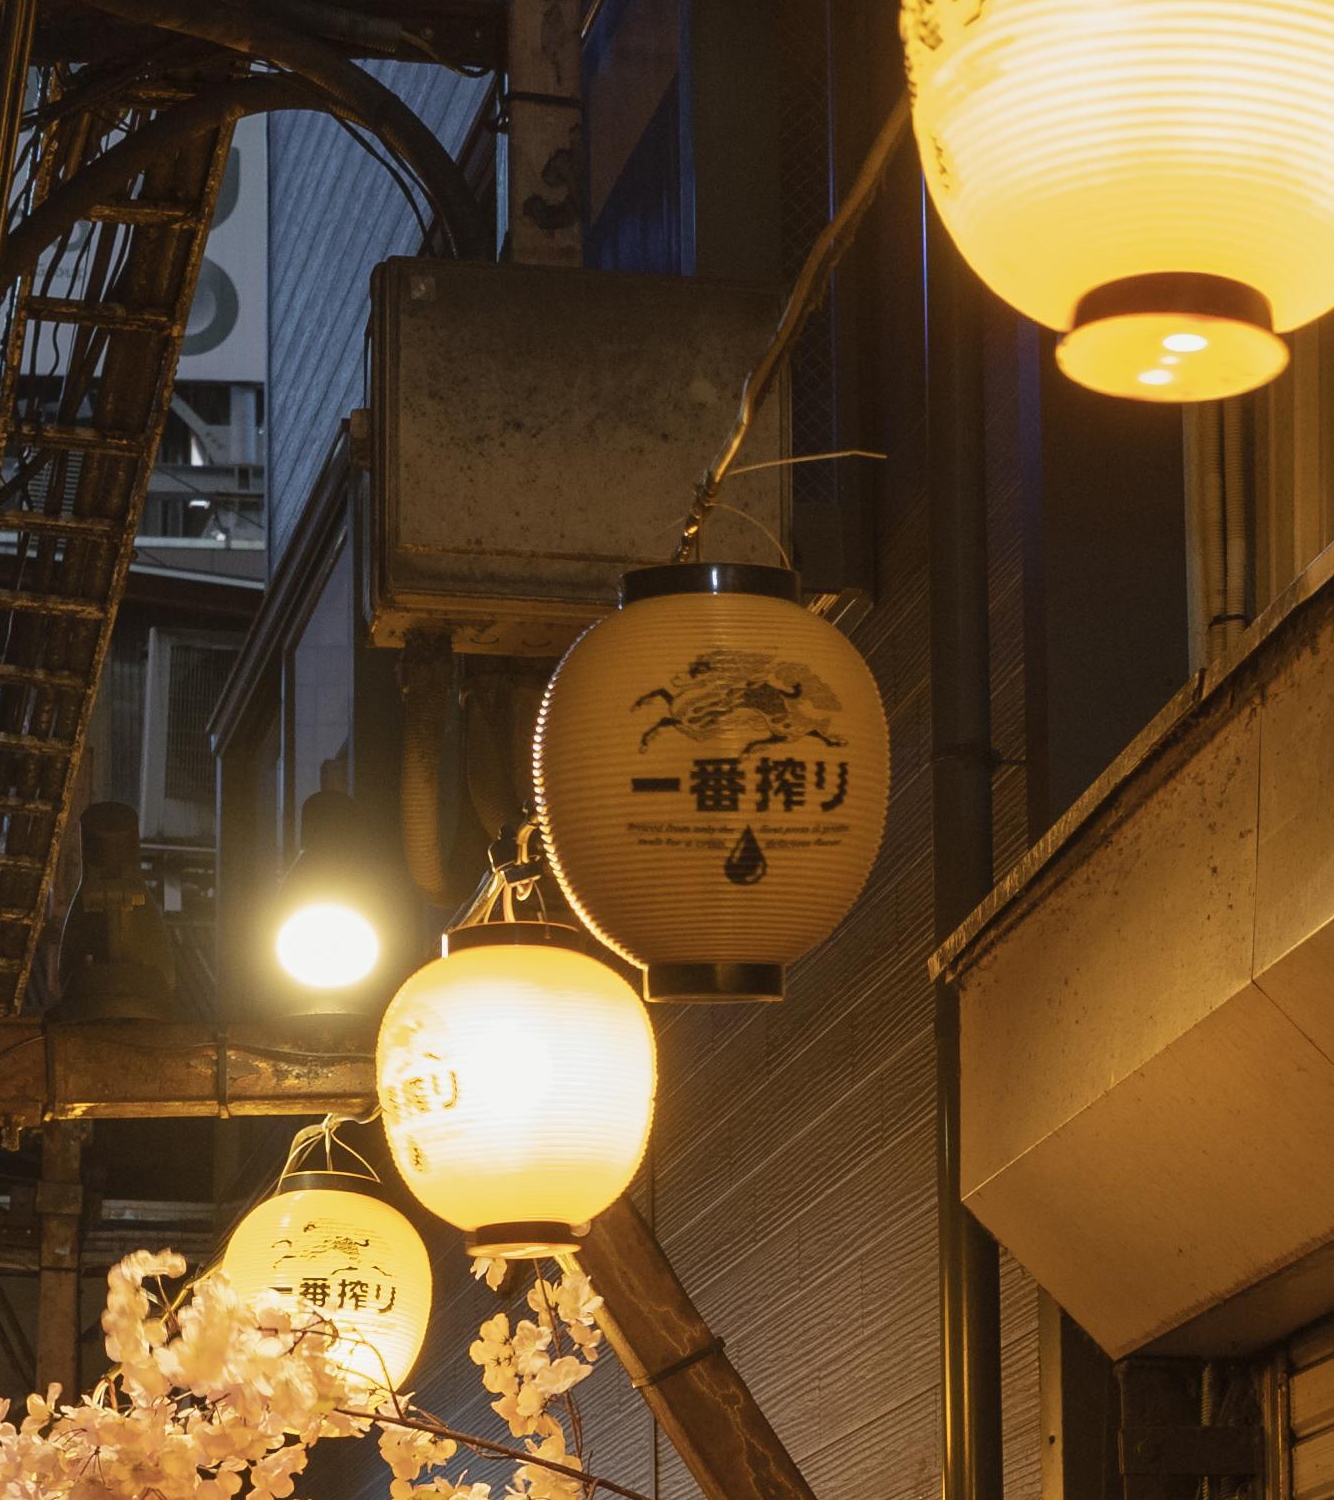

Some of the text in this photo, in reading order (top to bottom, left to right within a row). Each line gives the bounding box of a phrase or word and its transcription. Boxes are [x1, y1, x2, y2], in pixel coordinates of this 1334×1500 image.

[630, 756, 849, 813] 一番搾り
[267, 1276, 398, 1314] 一番搾り
